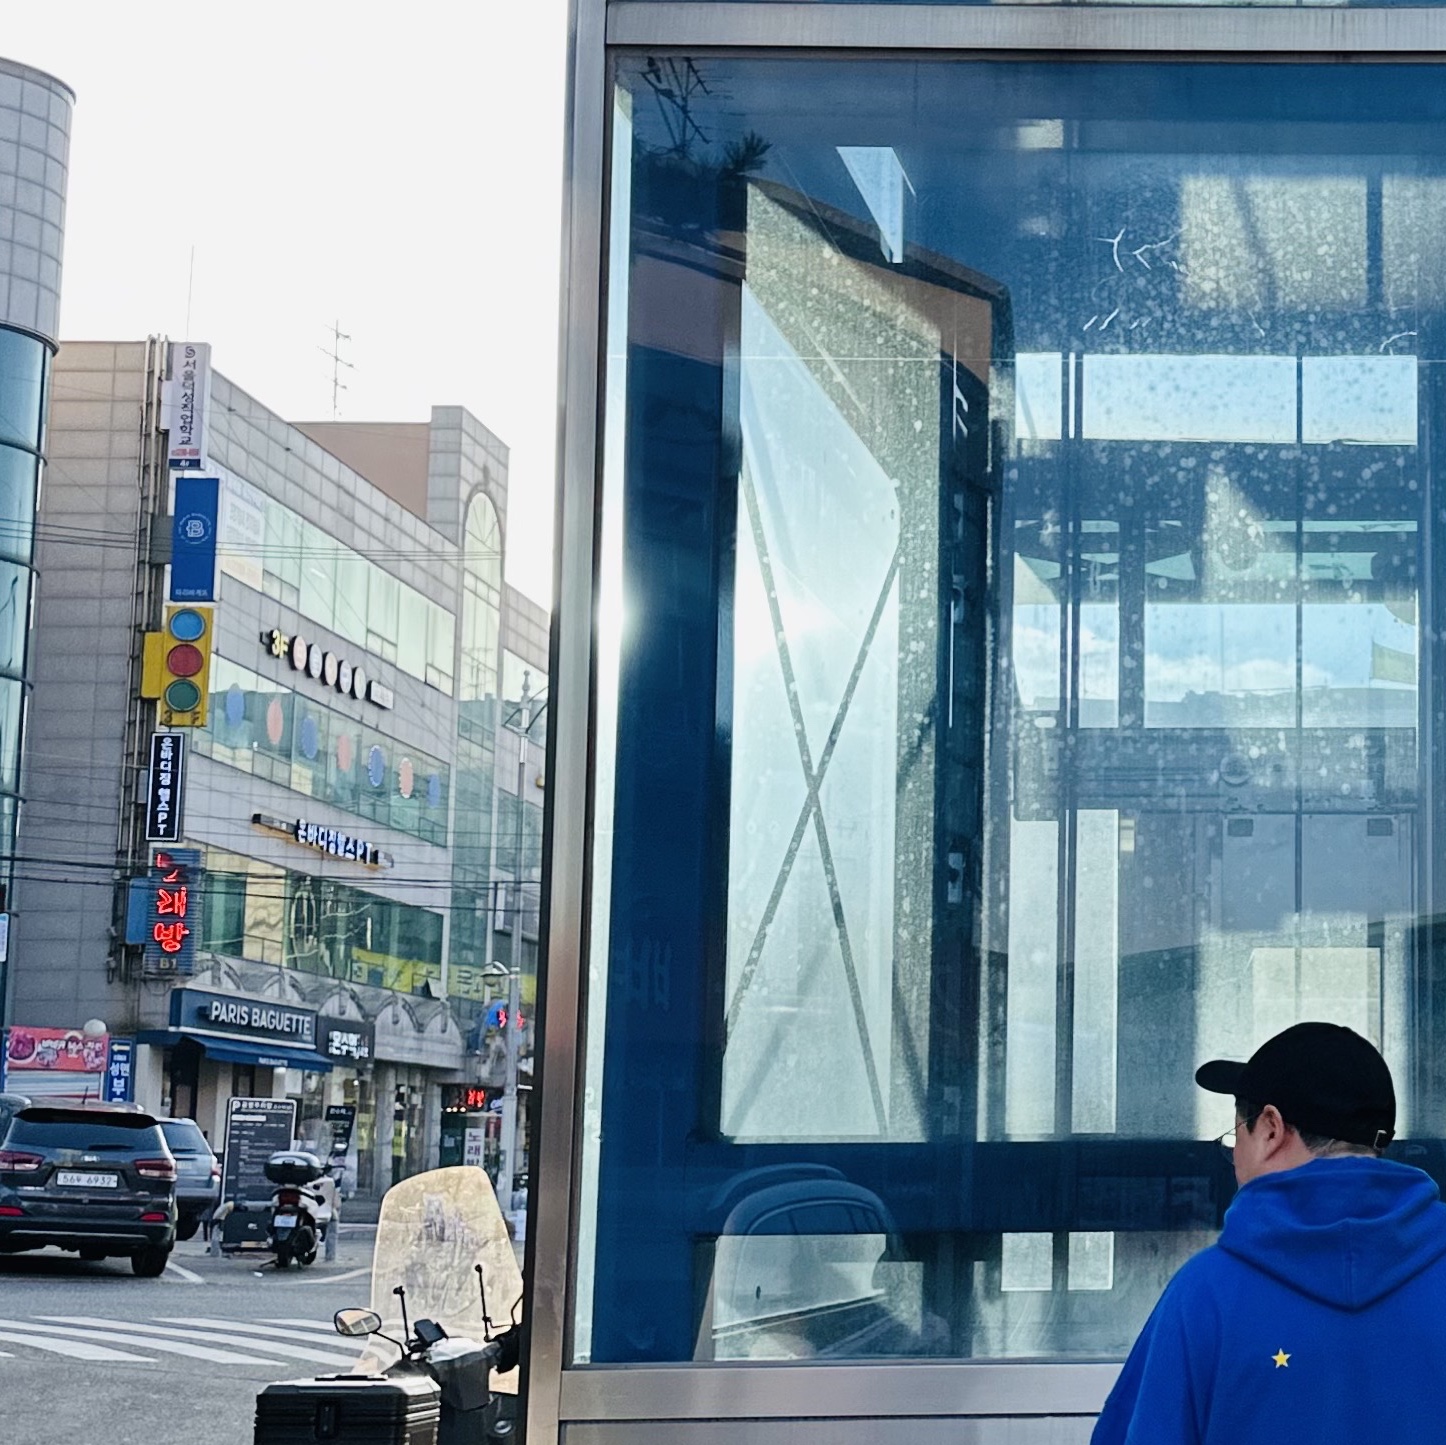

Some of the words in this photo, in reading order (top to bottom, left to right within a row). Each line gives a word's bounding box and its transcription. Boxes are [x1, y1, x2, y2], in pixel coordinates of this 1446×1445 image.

[271, 628, 289, 659] 3F
[210, 1000, 249, 1029] PARIS
[250, 1006, 312, 1035] BAGUETTE
